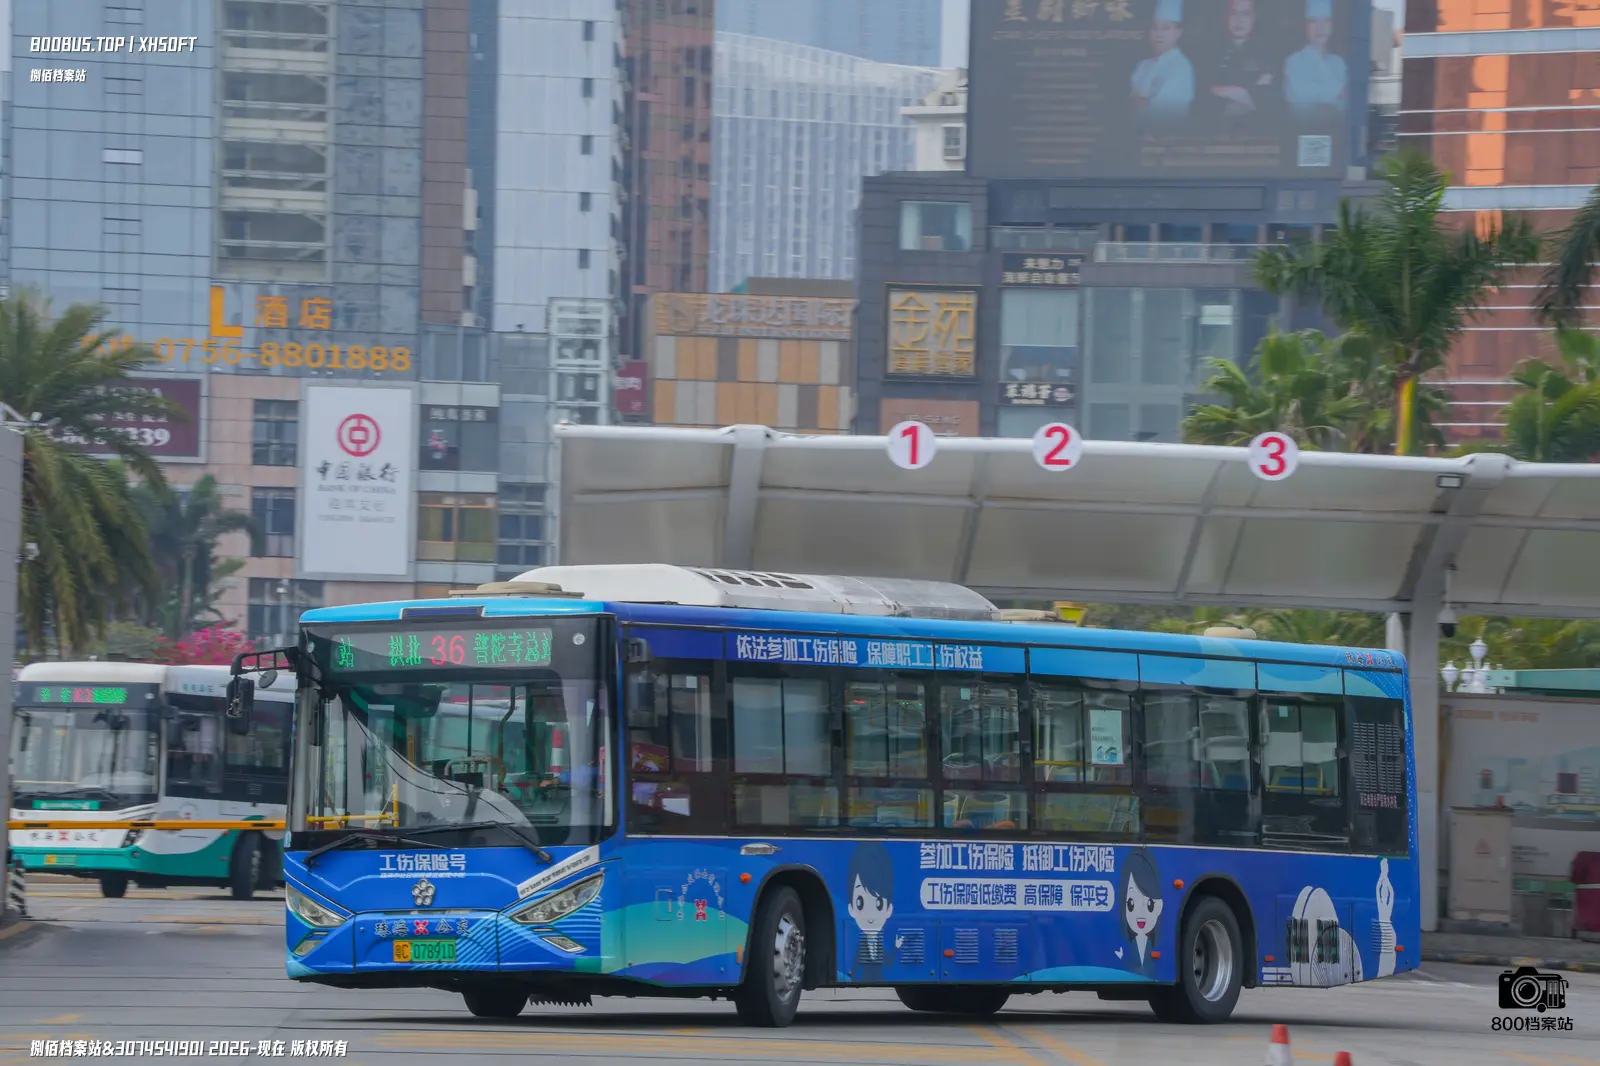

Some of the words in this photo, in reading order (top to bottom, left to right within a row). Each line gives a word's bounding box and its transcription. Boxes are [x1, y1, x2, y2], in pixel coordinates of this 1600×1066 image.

[254, 296, 333, 330] 酒店
[152, 337, 412, 371] 0756-8801888
[901, 426, 920, 465] 1
[1044, 426, 1071, 465] 2
[1260, 436, 1286, 476] 3
[431, 634, 466, 665] 36
[736, 635, 858, 664] 依法参加工伤保险
[866, 641, 983, 669] 保障职工工伤权益
[379, 854, 467, 871] 工伤保险号
[920, 843, 1014, 870] 参加工伤保险
[1022, 845, 1115, 872] 抵御工伤风险
[927, 883, 1017, 905] 工伤保险低缴费
[1024, 885, 1063, 906] 高保障
[1070, 885, 1109, 907] 保平安
[413, 944, 455, 959] 07891D
